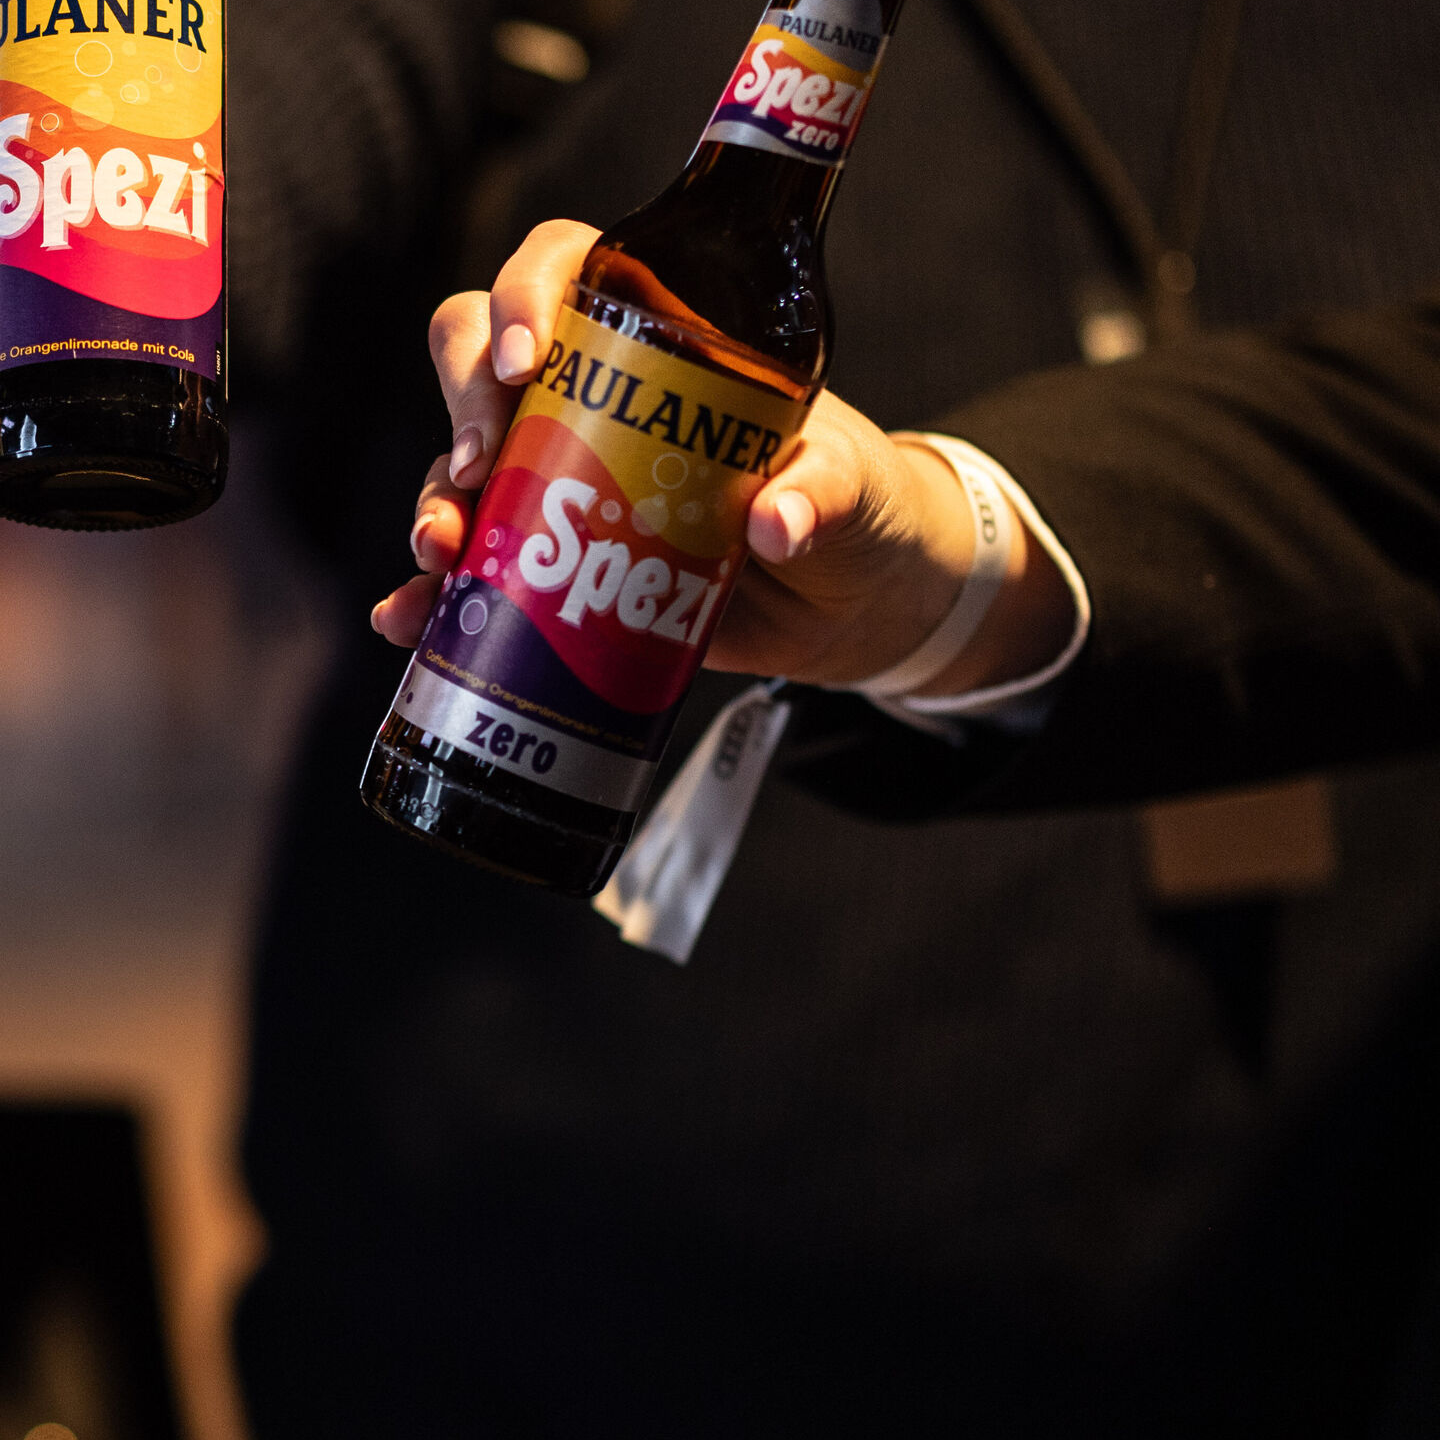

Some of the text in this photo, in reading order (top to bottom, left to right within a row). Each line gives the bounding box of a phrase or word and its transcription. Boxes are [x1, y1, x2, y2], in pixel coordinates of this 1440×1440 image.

[779, 15, 880, 54] PAULANER
[734, 38, 873, 126] Spezi
[783, 120, 840, 151] zero
[10, 338, 138, 358] Orangenlimonade
[142, 342, 165, 356] mit
[168, 345, 195, 362] Cola
[536, 339, 781, 479] PAULANER
[519, 478, 729, 647] Spezi
[465, 711, 558, 775] zero
